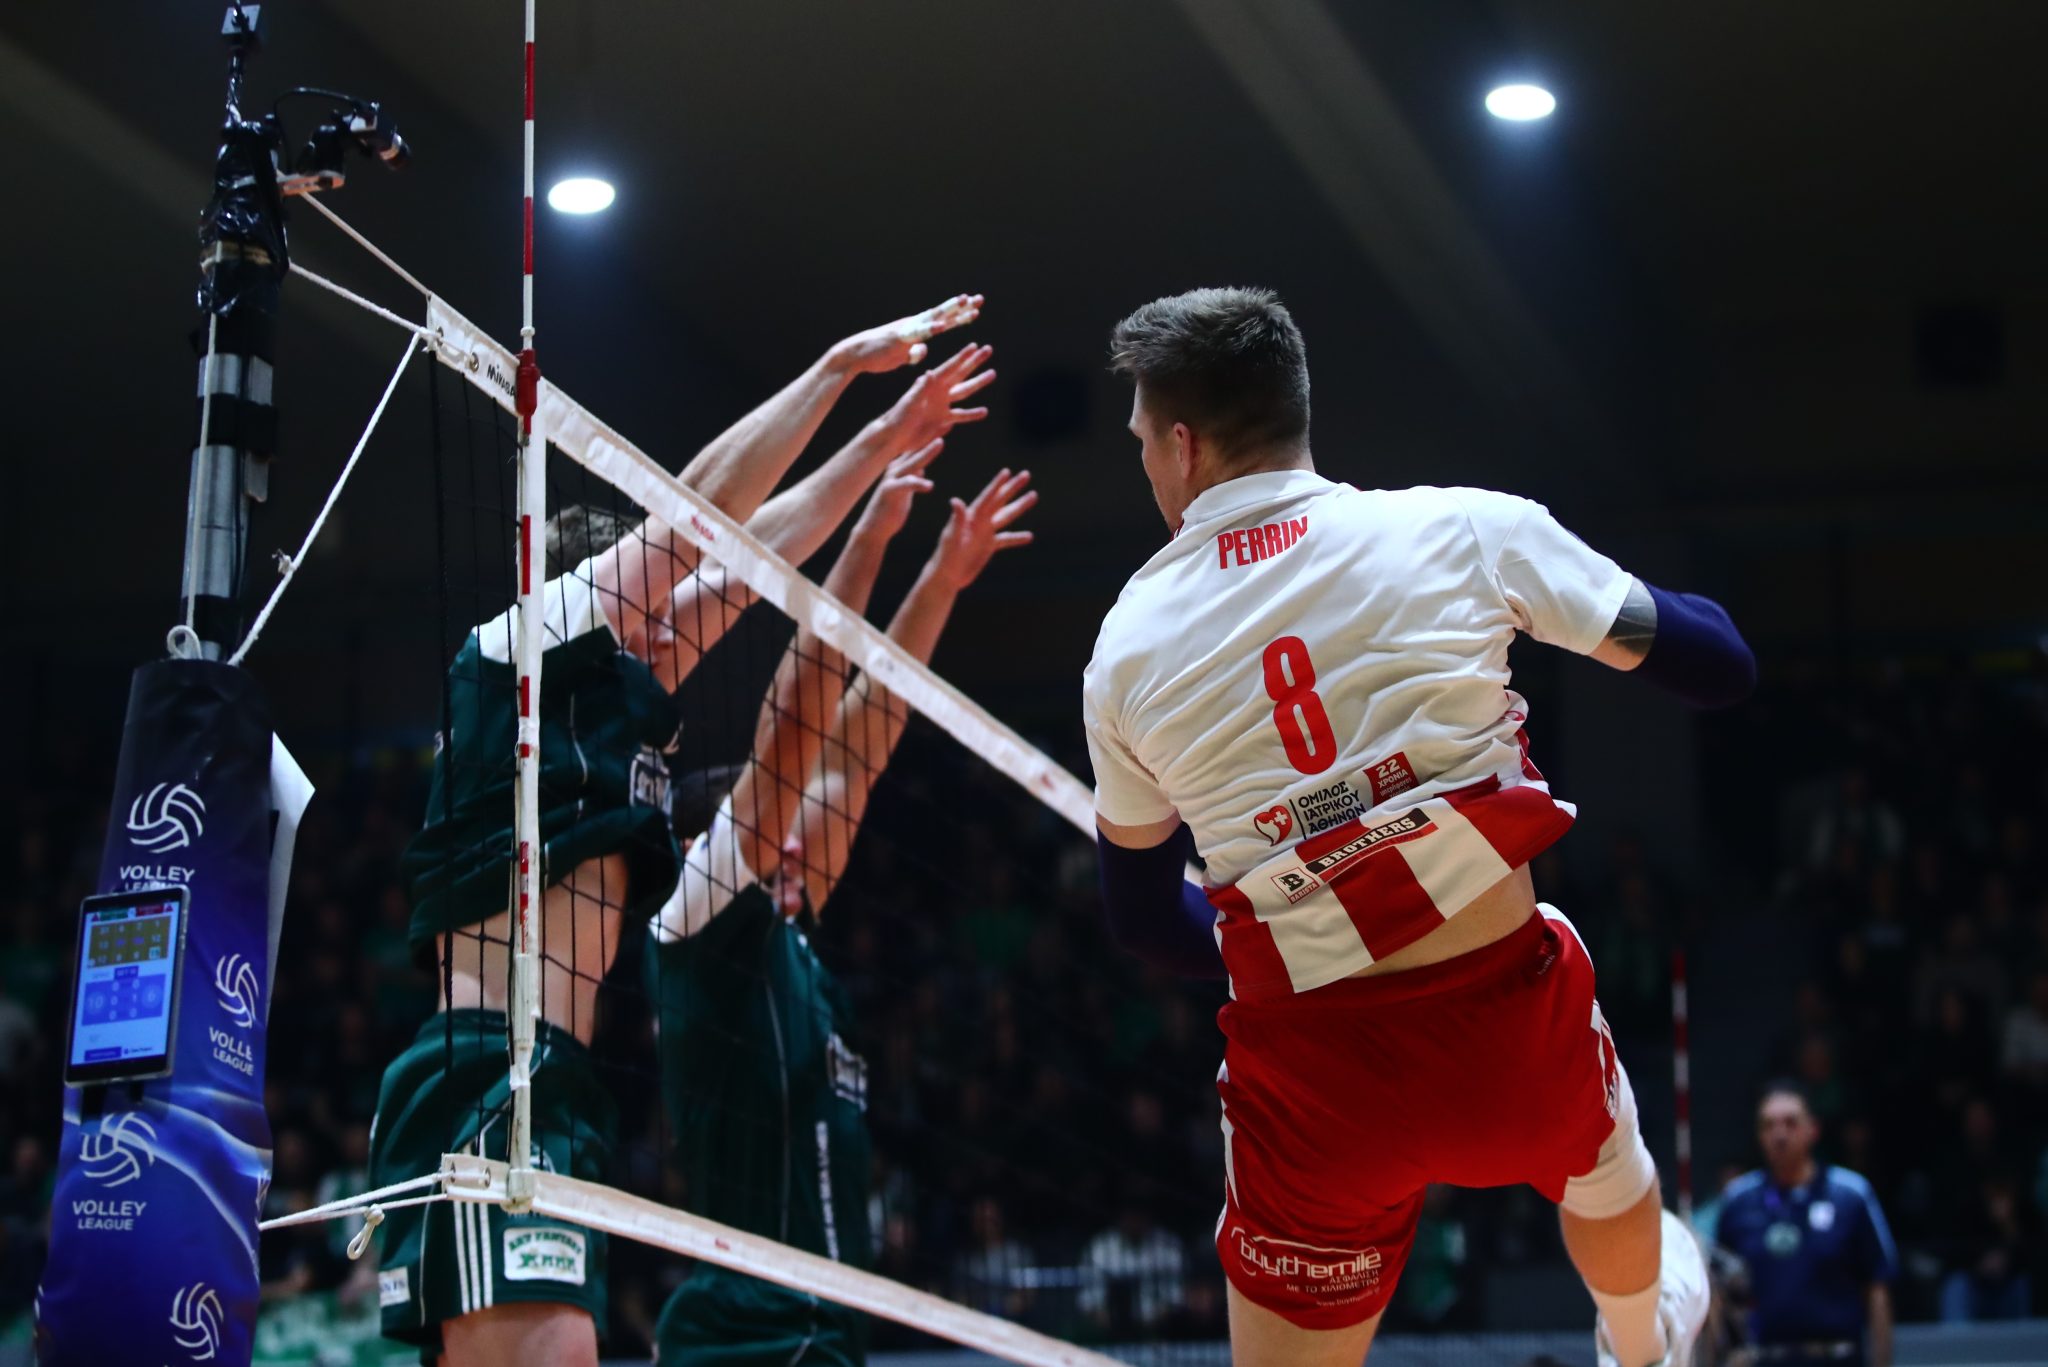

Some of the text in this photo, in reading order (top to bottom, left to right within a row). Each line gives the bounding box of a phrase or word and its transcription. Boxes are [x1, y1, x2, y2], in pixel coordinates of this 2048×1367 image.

[1217, 515, 1308, 570] PERRIN
[1262, 636, 1337, 775] 8
[1376, 759, 1400, 779] 22
[1377, 769, 1409, 789] ΧΡΟΝΙΑ
[1298, 781, 1349, 808] ΟΜΙΛΟΣ
[1303, 789, 1360, 821] ΙΑΤΡΙΚΟΥ
[1308, 803, 1367, 834] ΑΘΗΝΩΝ
[1318, 817, 1416, 867] BROTHERS
[120, 865, 195, 882] VOLLEY
[213, 1047, 254, 1077] LEAGUE
[72, 1199, 147, 1217] VOLLEY
[77, 1217, 134, 1231] LEAGUE
[1240, 1236, 1382, 1279] buythemile
[1305, 1285, 1318, 1294] ΤΟ
